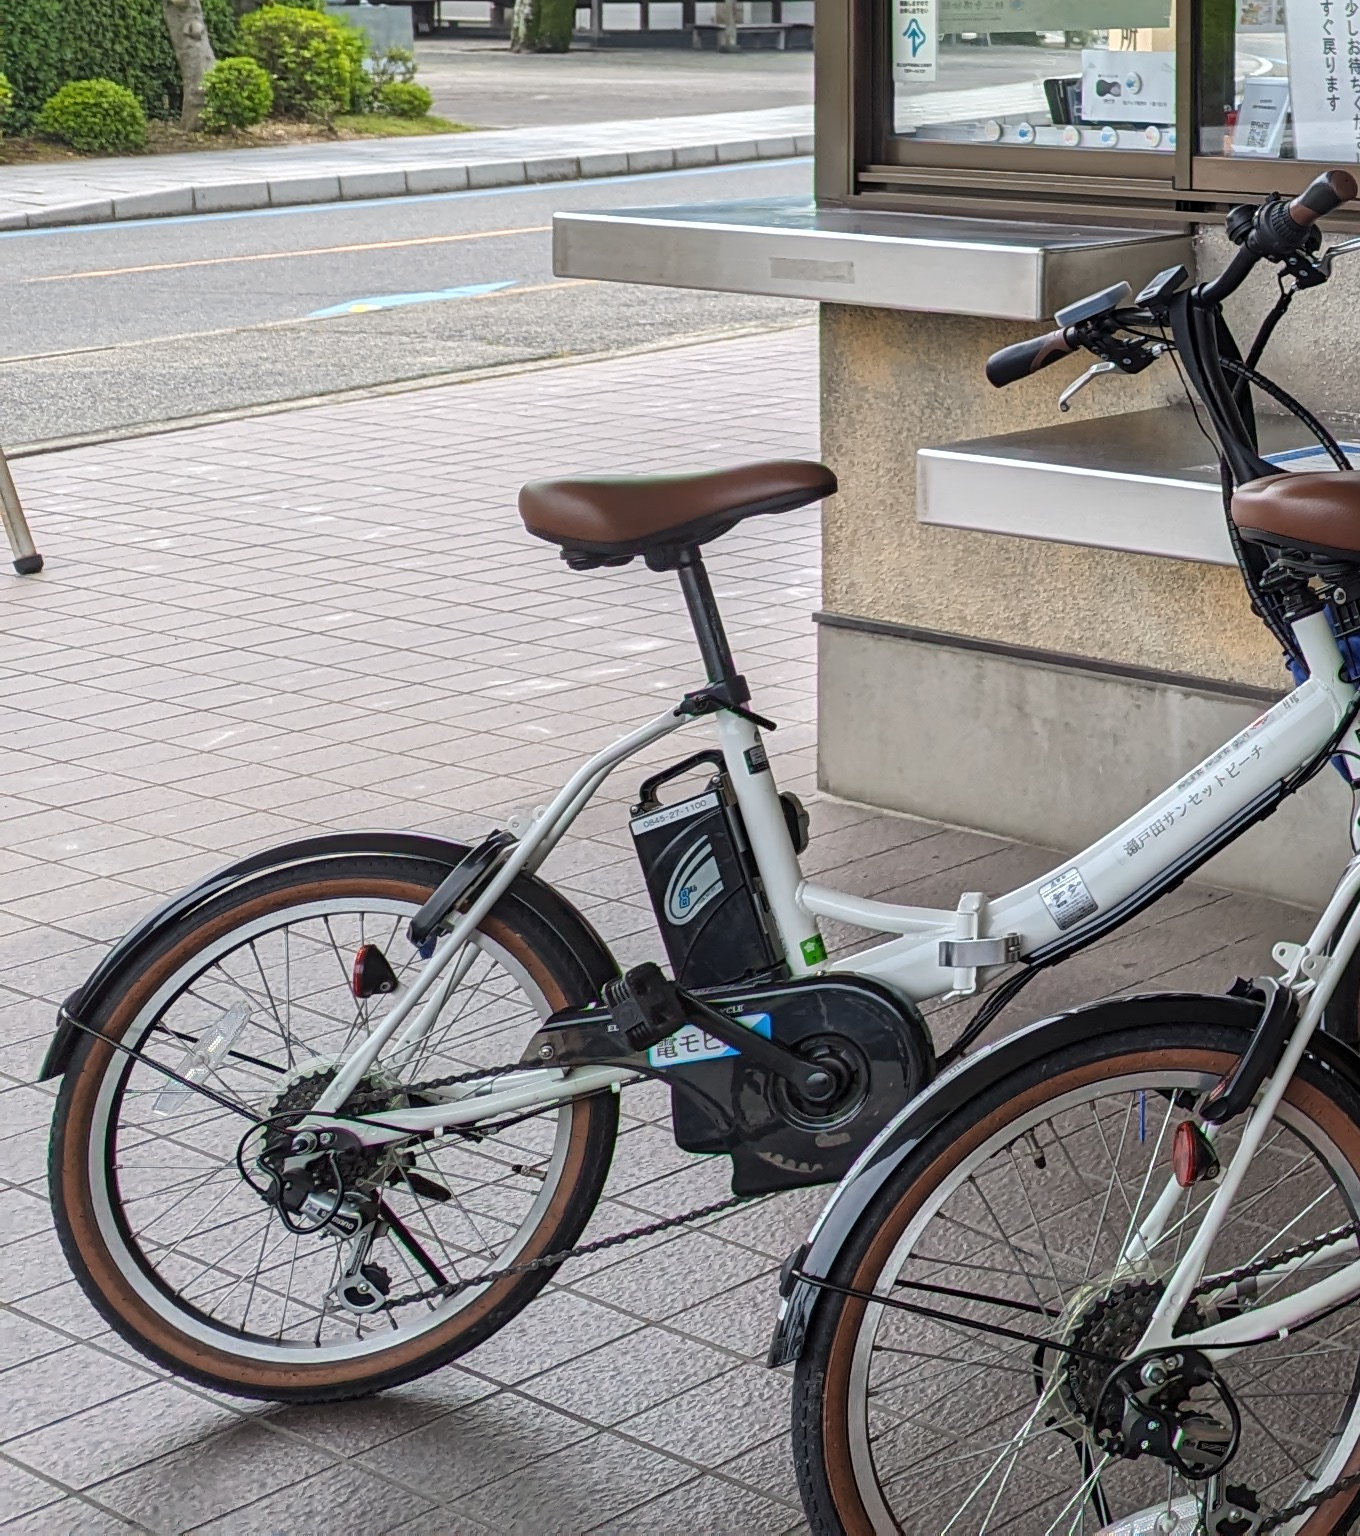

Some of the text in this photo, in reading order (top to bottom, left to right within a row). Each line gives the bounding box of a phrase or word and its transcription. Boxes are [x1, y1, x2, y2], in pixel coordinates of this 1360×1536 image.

[1319, 0, 1341, 112] すぐ戻ります
[643, 799, 708, 829] 0845-27-1100
[1122, 744, 1264, 858] 瀬戸田サンセットビーチ
